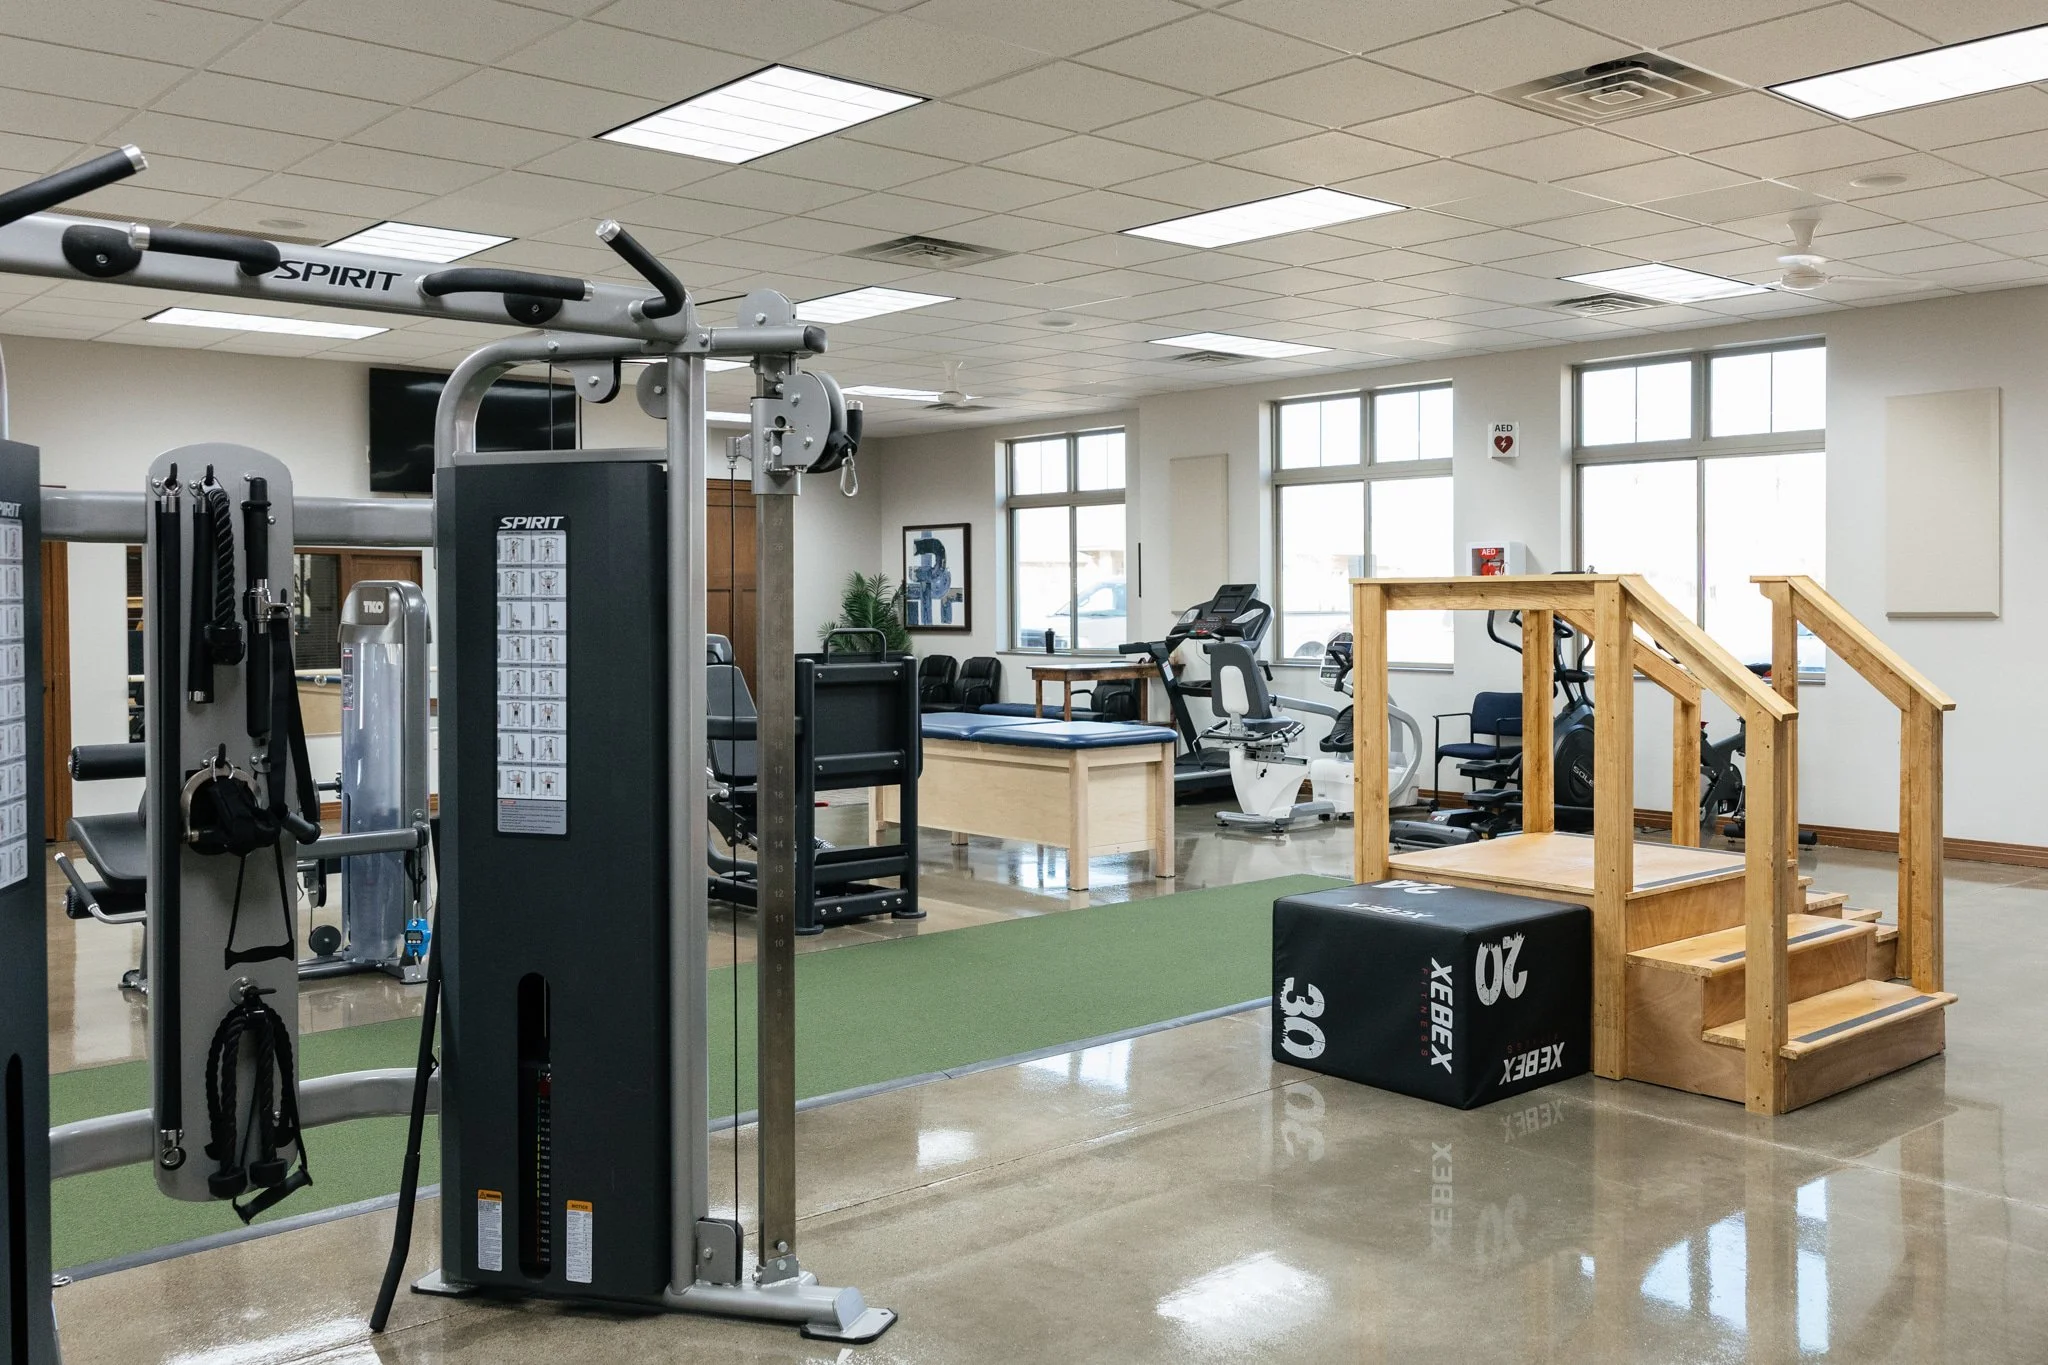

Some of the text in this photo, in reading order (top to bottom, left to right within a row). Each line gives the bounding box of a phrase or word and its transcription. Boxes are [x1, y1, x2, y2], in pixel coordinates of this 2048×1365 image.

[273, 260, 403, 291] SPIRIT
[1495, 424, 1513, 432] AED
[498, 516, 565, 530] SPIRIT
[1481, 548, 1496, 556] AED
[363, 601, 384, 614] TKO
[774, 840, 784, 849] 14
[774, 864, 784, 873] 13
[774, 889, 784, 898] 12
[774, 939, 784, 948] 10
[1475, 931, 1528, 1006] 20
[1280, 977, 1326, 1059] 30
[1420, 967, 1429, 1057] FITNESS
[1430, 957, 1453, 1075] XEBEX
[1499, 1041, 1565, 1085] XEBEX
